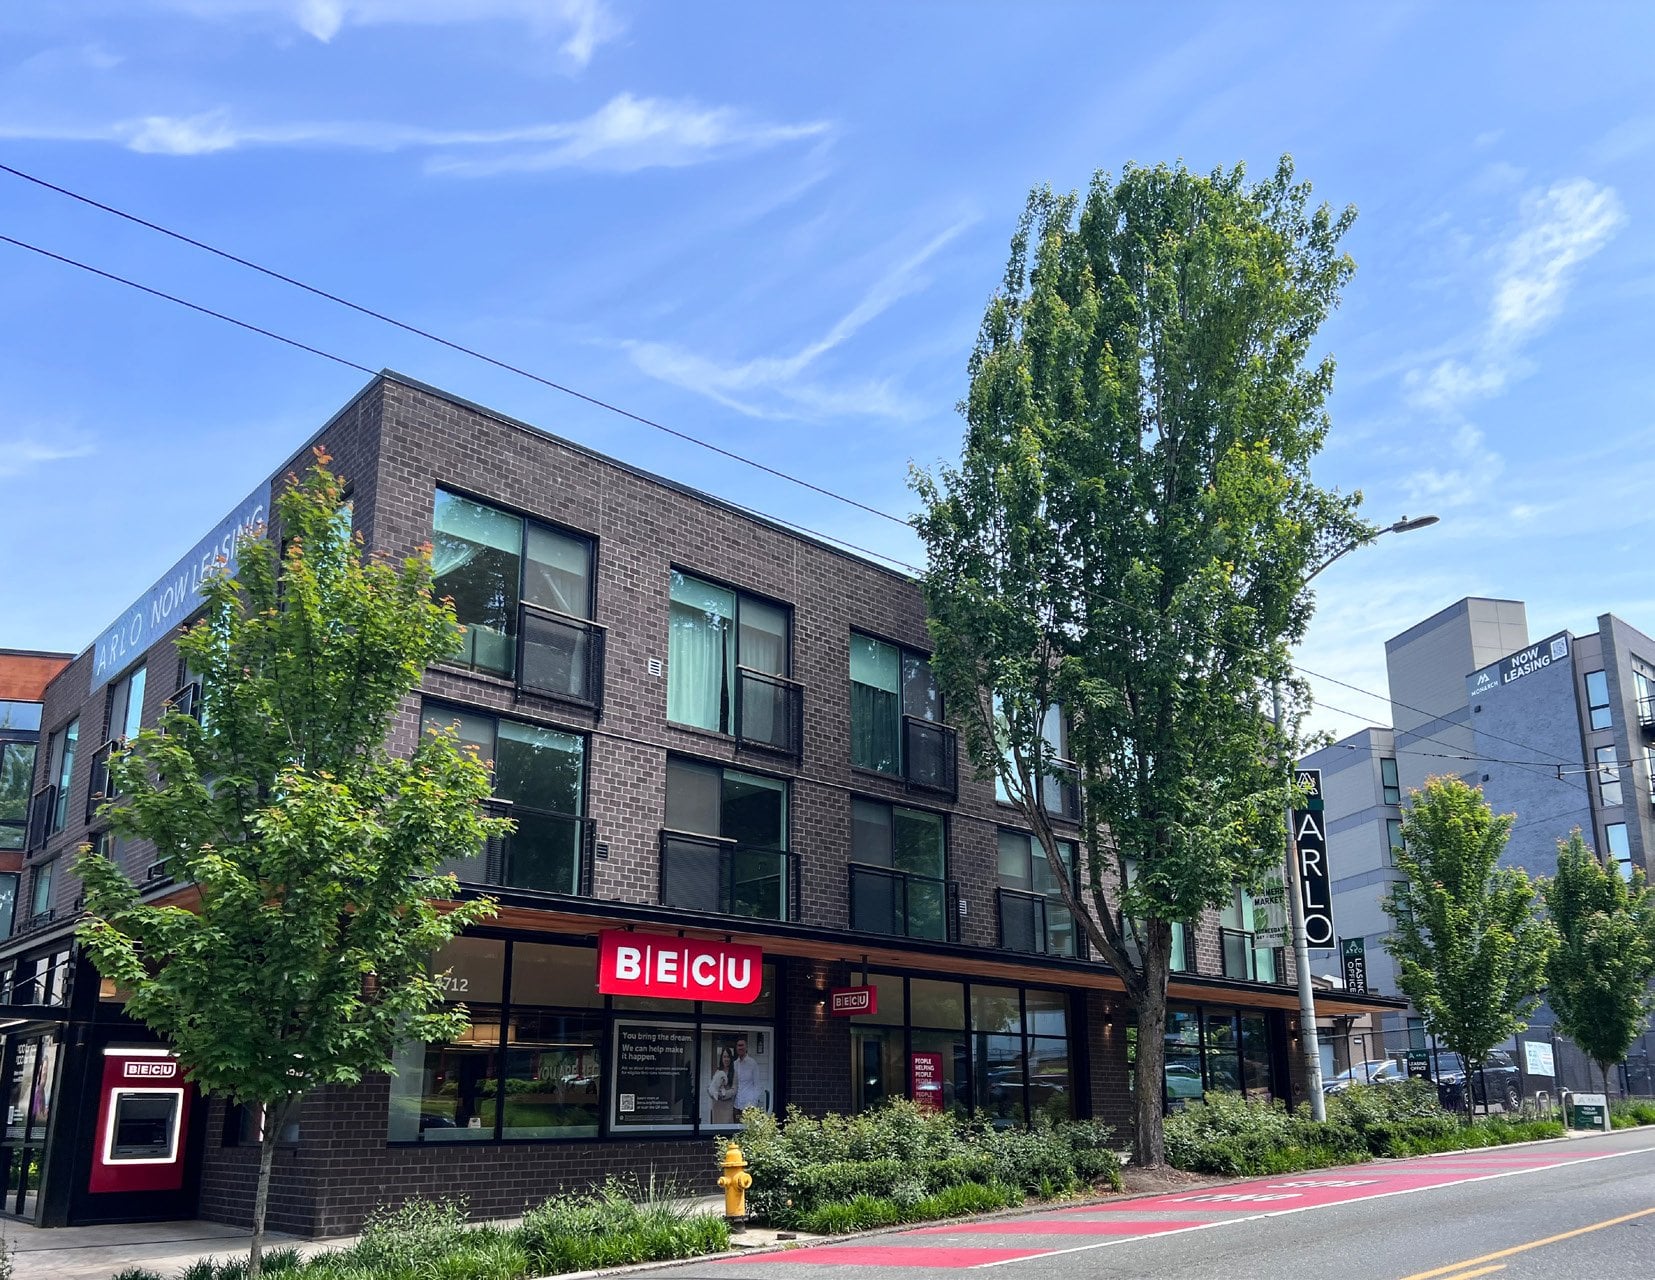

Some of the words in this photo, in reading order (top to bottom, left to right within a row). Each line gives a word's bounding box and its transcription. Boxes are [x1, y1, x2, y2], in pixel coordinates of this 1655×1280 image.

[96, 614, 142, 676] ARLO
[151, 571, 189, 628] NOW
[1511, 647, 1539, 668] NOW
[1504, 655, 1550, 683] LEASING
[1471, 681, 1499, 697] MONARCH
[1297, 814, 1332, 943] ARLO
[1255, 896, 1283, 906] MARKET
[615, 945, 751, 991] BECU
[1348, 962, 1356, 993] OFFICE
[836, 995, 866, 1007] BECU
[622, 1032, 636, 1040] You
[638, 1033, 656, 1042] bring
[648, 1045, 664, 1054] help
[129, 1065, 172, 1075] BECU
